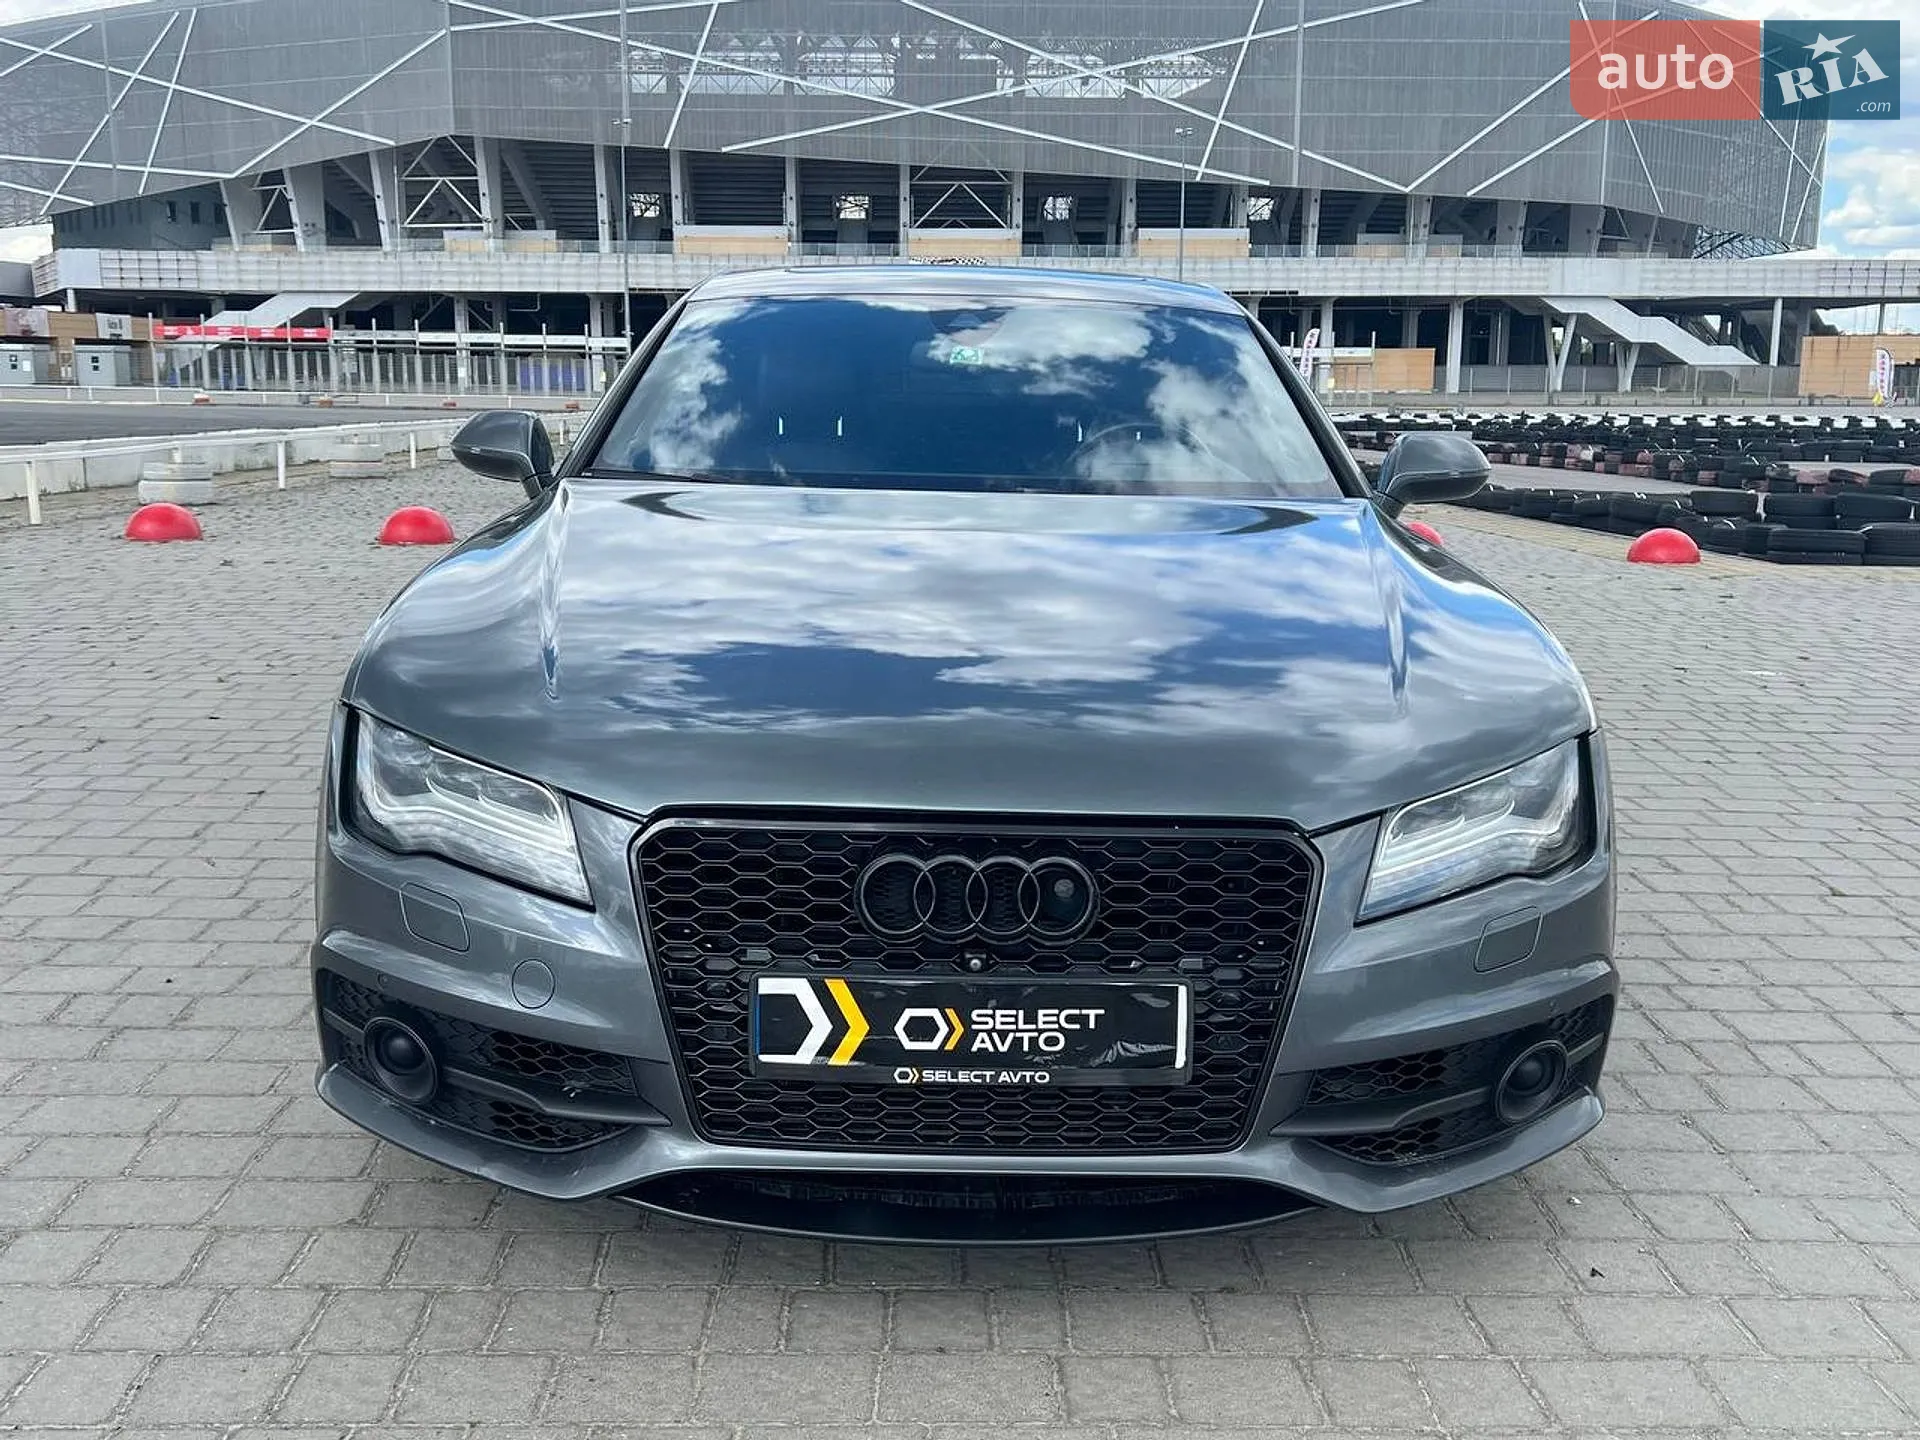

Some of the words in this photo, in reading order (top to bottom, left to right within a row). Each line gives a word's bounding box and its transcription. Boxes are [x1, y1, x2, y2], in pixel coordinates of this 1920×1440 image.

[971, 1009, 1105, 1030] SELECT
[971, 1031, 1066, 1053] AVTO
[922, 1070, 996, 1084] SELECT
[998, 1070, 1050, 1084] AVTO
